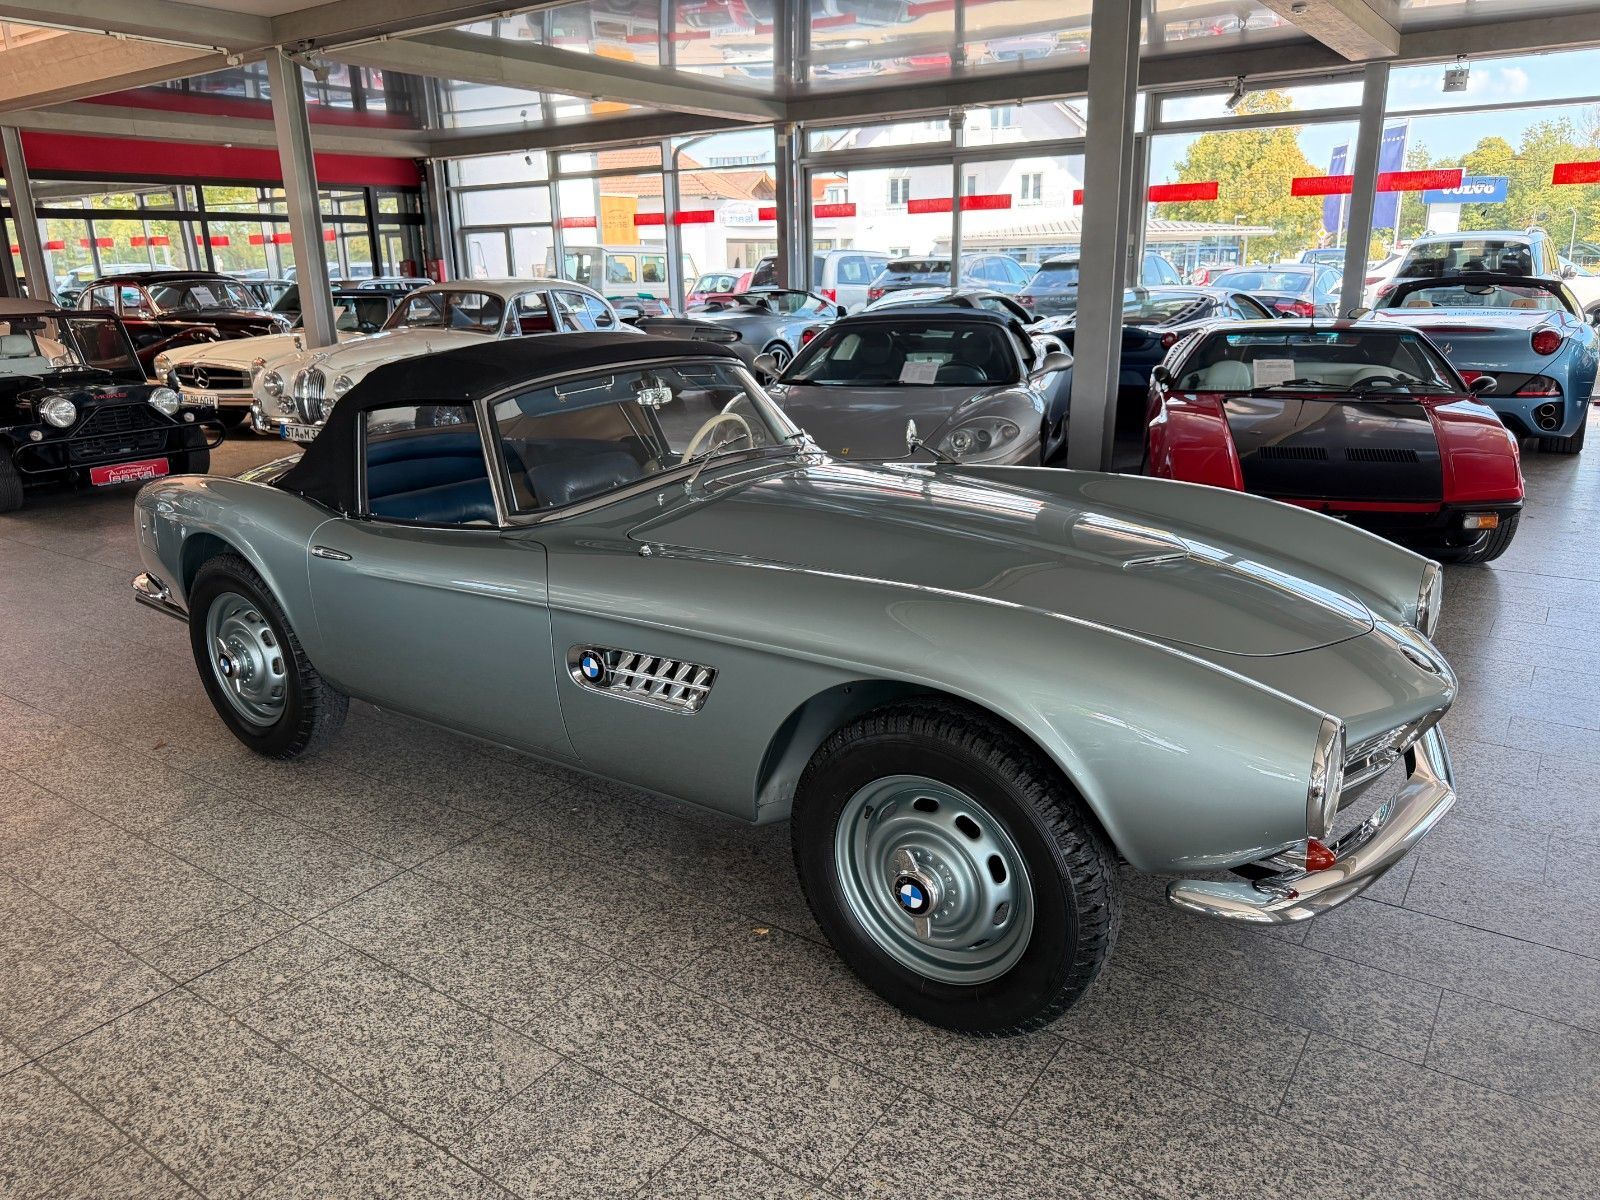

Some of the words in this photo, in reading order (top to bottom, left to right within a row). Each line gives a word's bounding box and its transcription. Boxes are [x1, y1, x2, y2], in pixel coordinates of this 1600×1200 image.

[1441, 184, 1495, 195] VOLVO
[285, 426, 299, 438] STA
[304, 428, 310, 439] M
[109, 466, 152, 475] Autosalon
